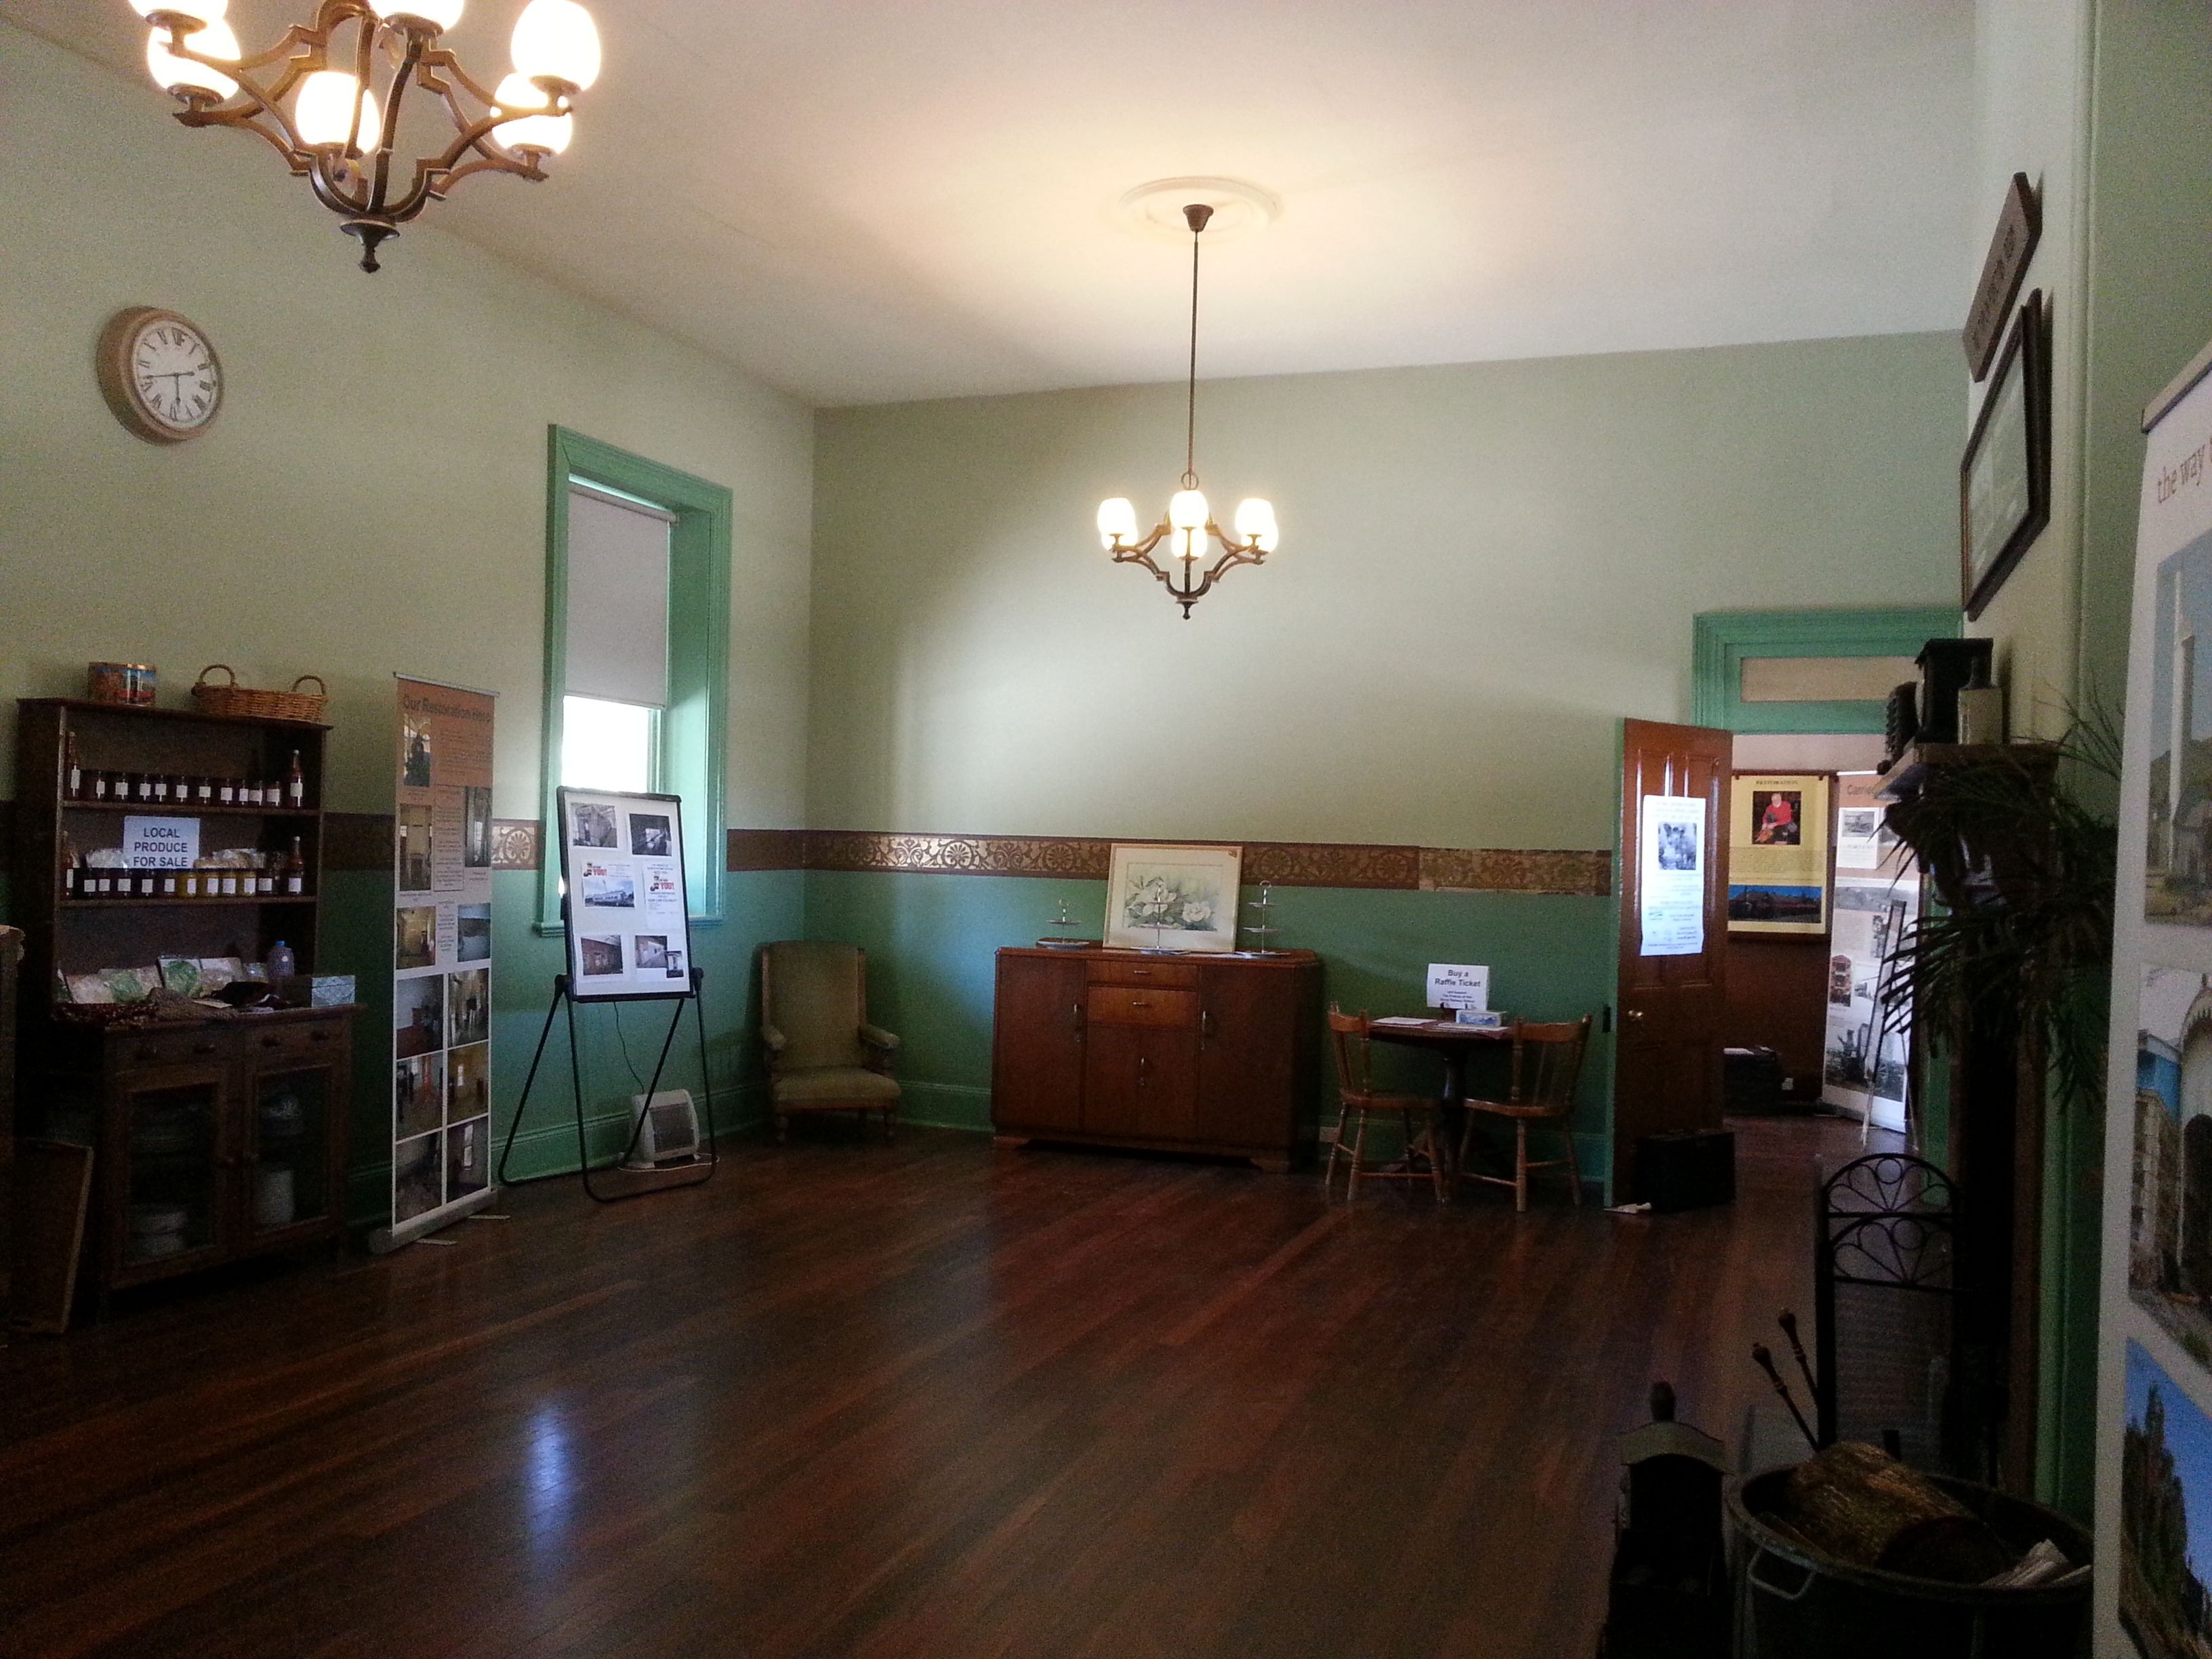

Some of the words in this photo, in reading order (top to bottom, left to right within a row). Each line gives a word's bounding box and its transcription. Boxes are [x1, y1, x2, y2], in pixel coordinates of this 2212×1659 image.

[2158, 466, 2177, 504] the
[2180, 444, 2206, 486] way
[403, 694, 421, 712] Our
[143, 827, 180, 838] LOCAL
[134, 841, 188, 853] PRODUCE
[133, 857, 156, 867] FOR
[159, 857, 188, 867] SALE
[1448, 969, 1462, 978] Buy
[1435, 978, 1456, 986] Raffle
[1458, 979, 1481, 987] Ticket
